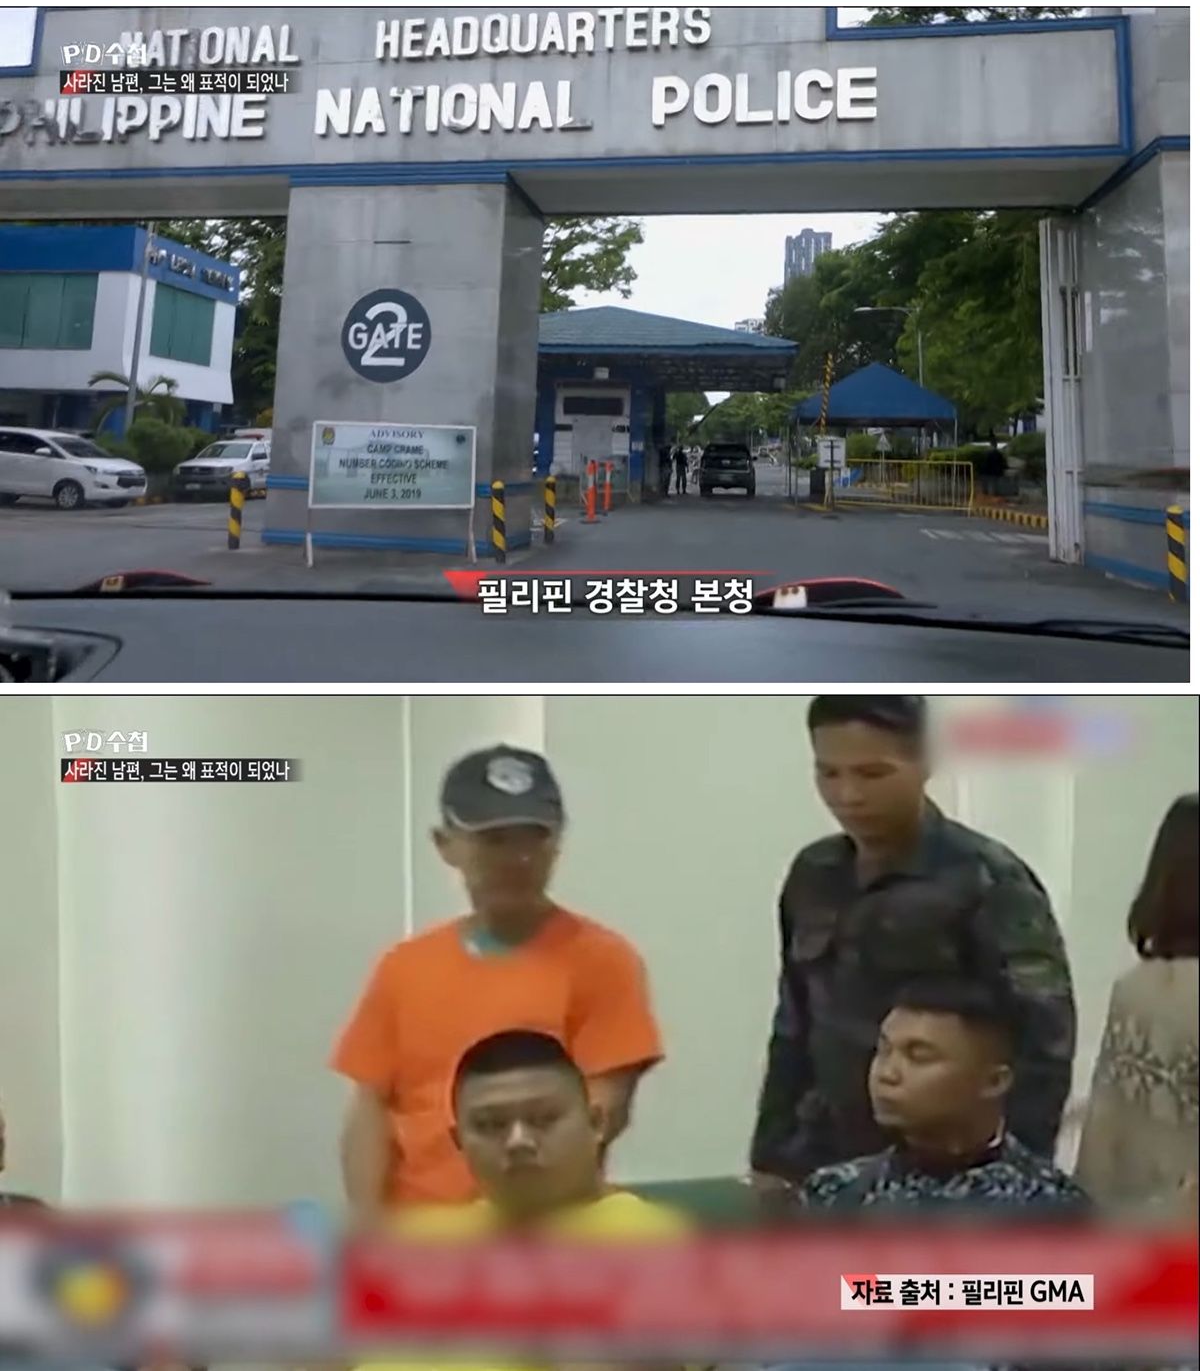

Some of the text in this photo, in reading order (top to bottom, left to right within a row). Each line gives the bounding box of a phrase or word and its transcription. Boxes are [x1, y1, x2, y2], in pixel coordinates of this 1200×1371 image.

[374, 6, 712, 60] HEADQUARTERS
[314, 79, 594, 137] NATIONAL
[651, 66, 878, 127] POLICE
[348, 322, 424, 350] GATE
[370, 429, 425, 439] ADVISORY
[366, 443, 392, 454] CAMP
[339, 458, 376, 469] NUMBER
[414, 460, 449, 470] SCHEME
[370, 473, 418, 484] EFFECTIVE
[363, 488, 422, 500] JUNE 3, 2019
